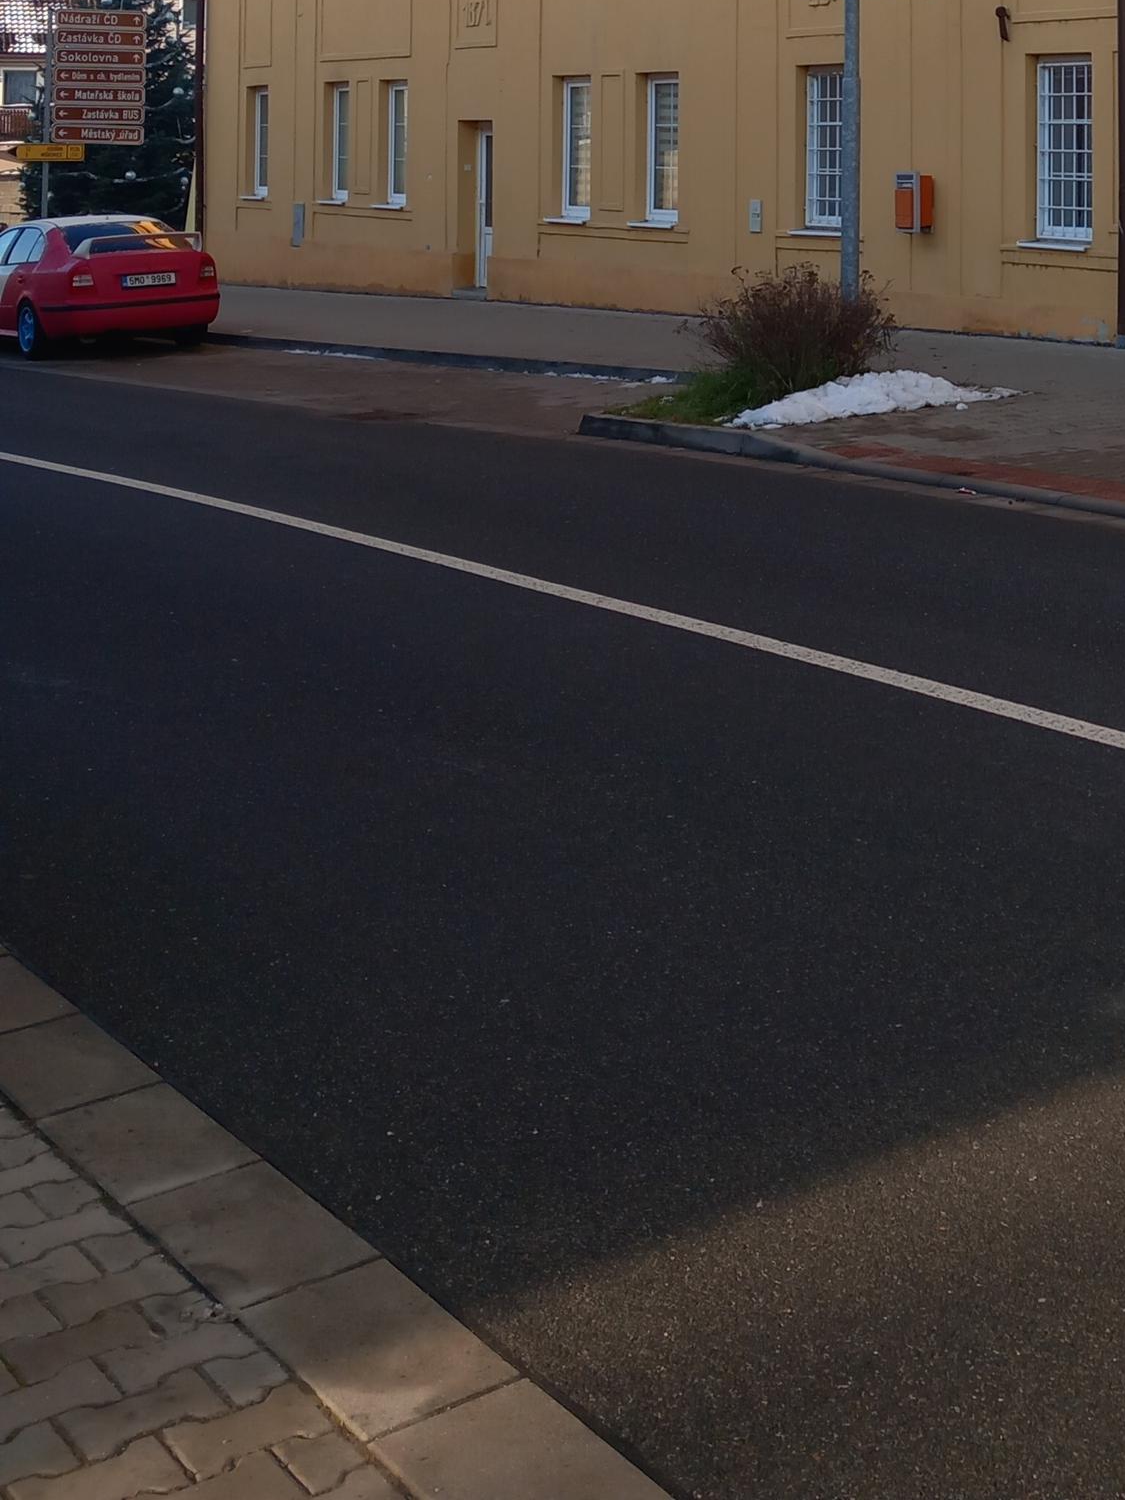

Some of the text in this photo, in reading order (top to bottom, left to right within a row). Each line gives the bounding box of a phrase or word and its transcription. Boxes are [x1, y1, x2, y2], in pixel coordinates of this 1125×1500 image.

[60, 13, 118, 25] Nádraží ČD
[60, 32, 122, 44] Zastávka ČD
[60, 51, 119, 63] Sokolovna
[75, 90, 140, 100] Mateřská škola
[82, 109, 140, 120] Zastávka BUS
[81, 128, 116, 141] Městský
